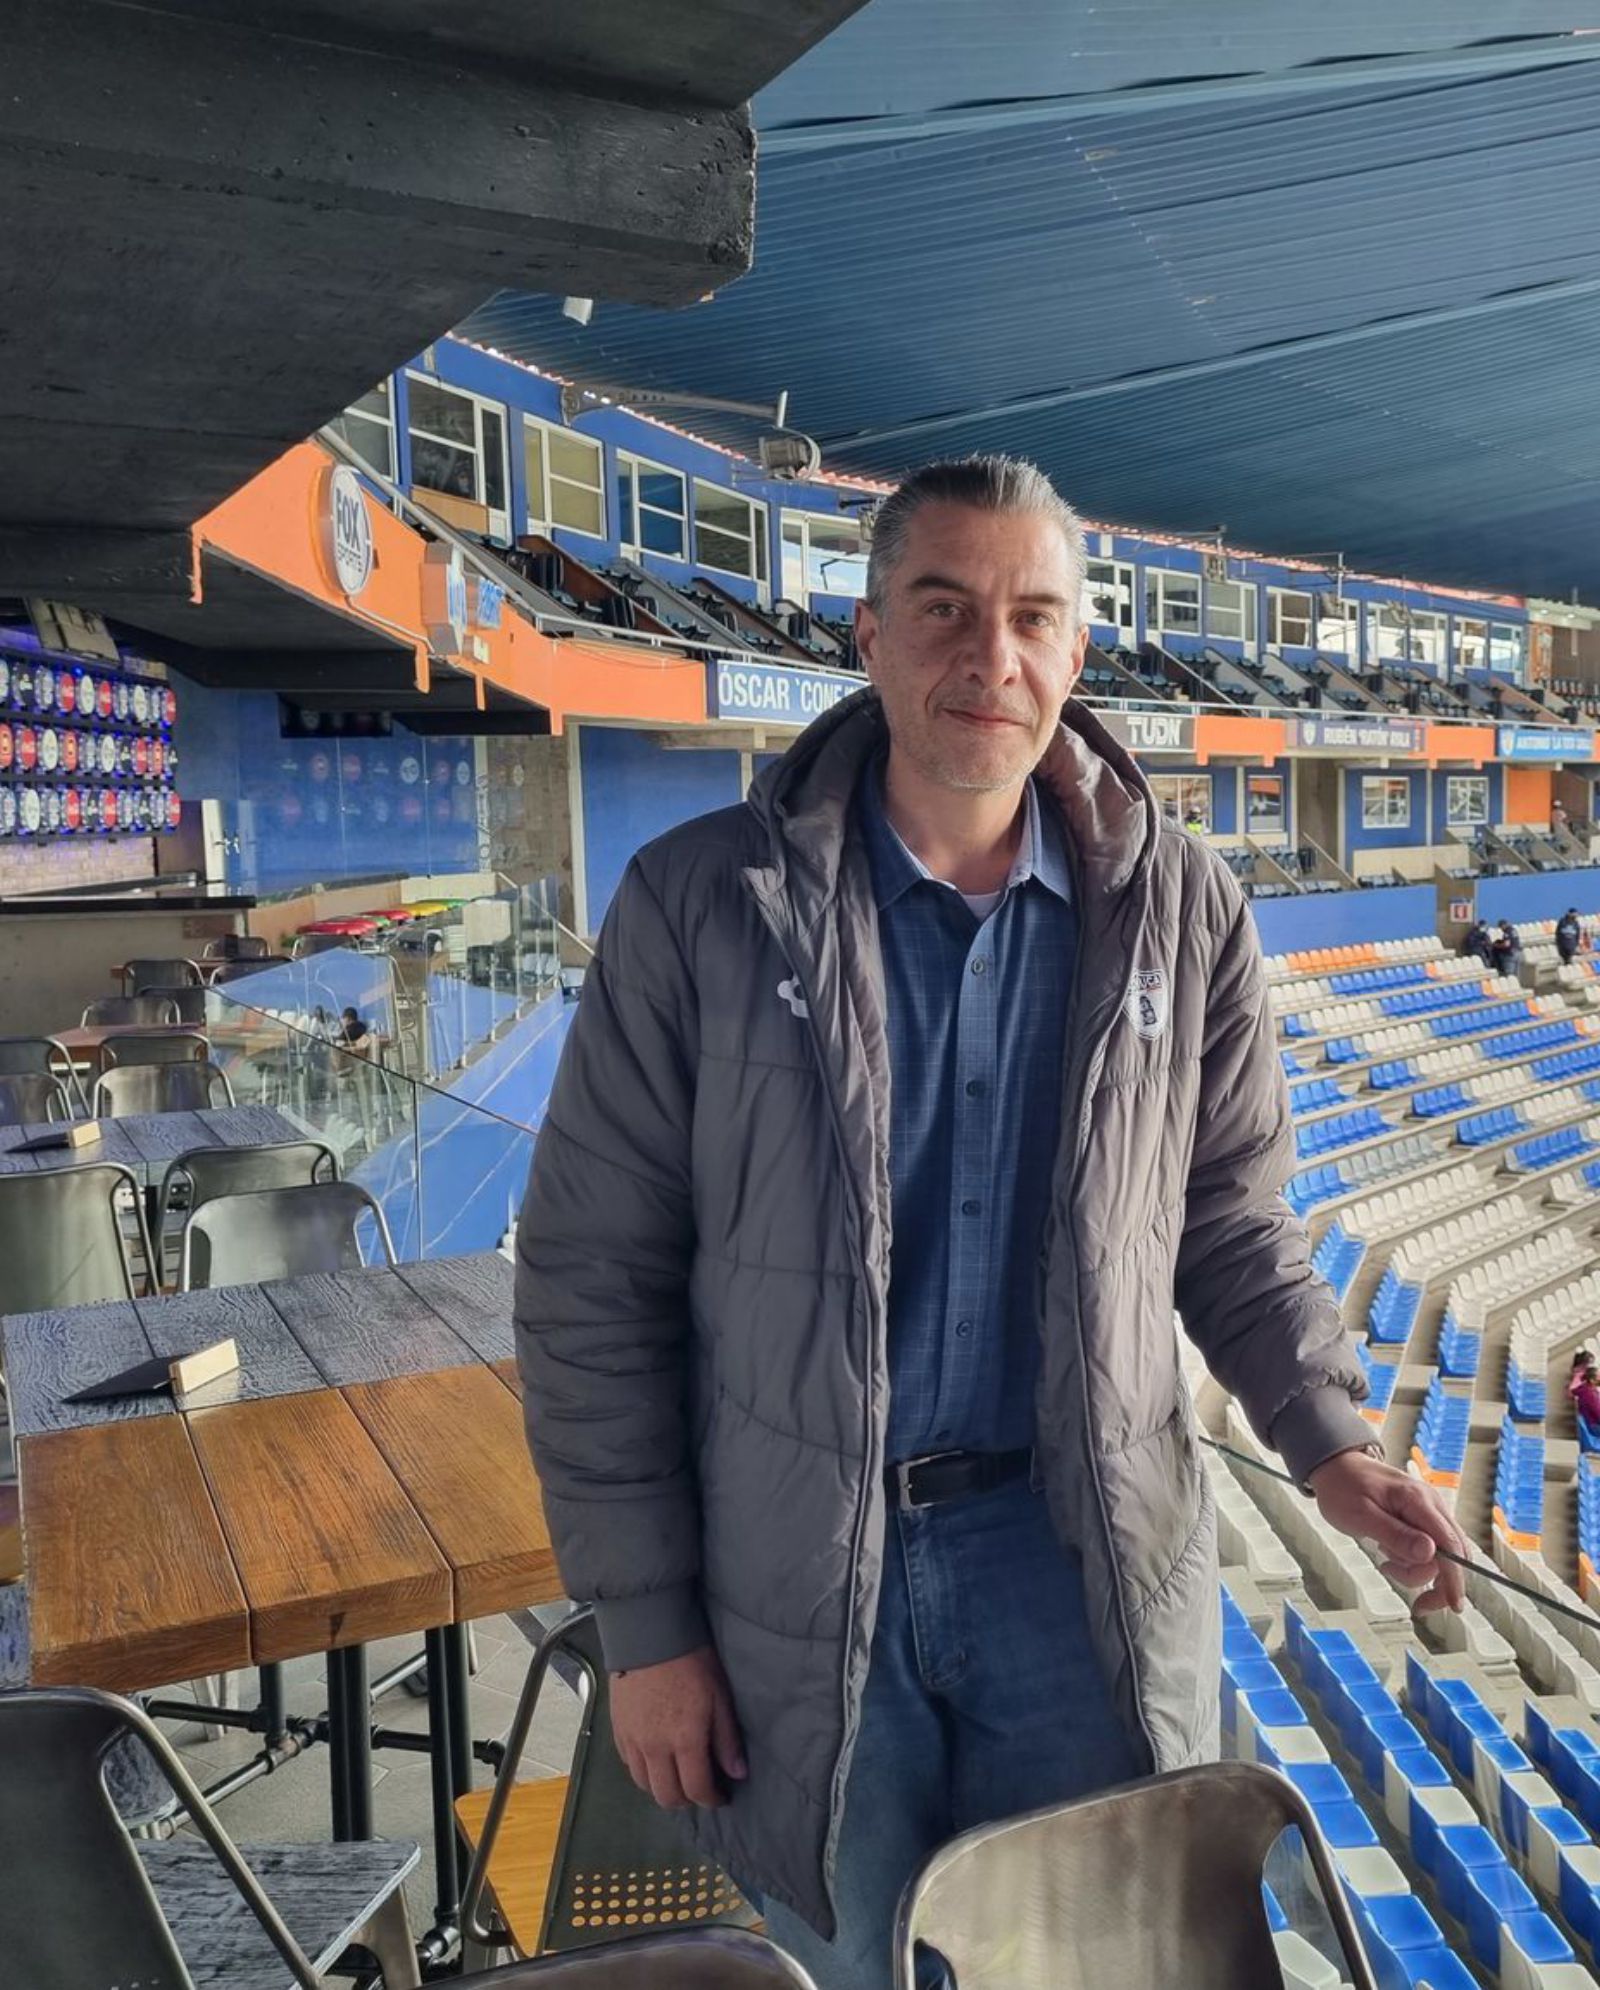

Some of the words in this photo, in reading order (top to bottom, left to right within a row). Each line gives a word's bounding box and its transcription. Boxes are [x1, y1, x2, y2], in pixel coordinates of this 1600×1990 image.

[335, 487, 361, 552] FOX
[718, 664, 791, 711] ÓSCAR
[1126, 716, 1183, 747] TUDN
